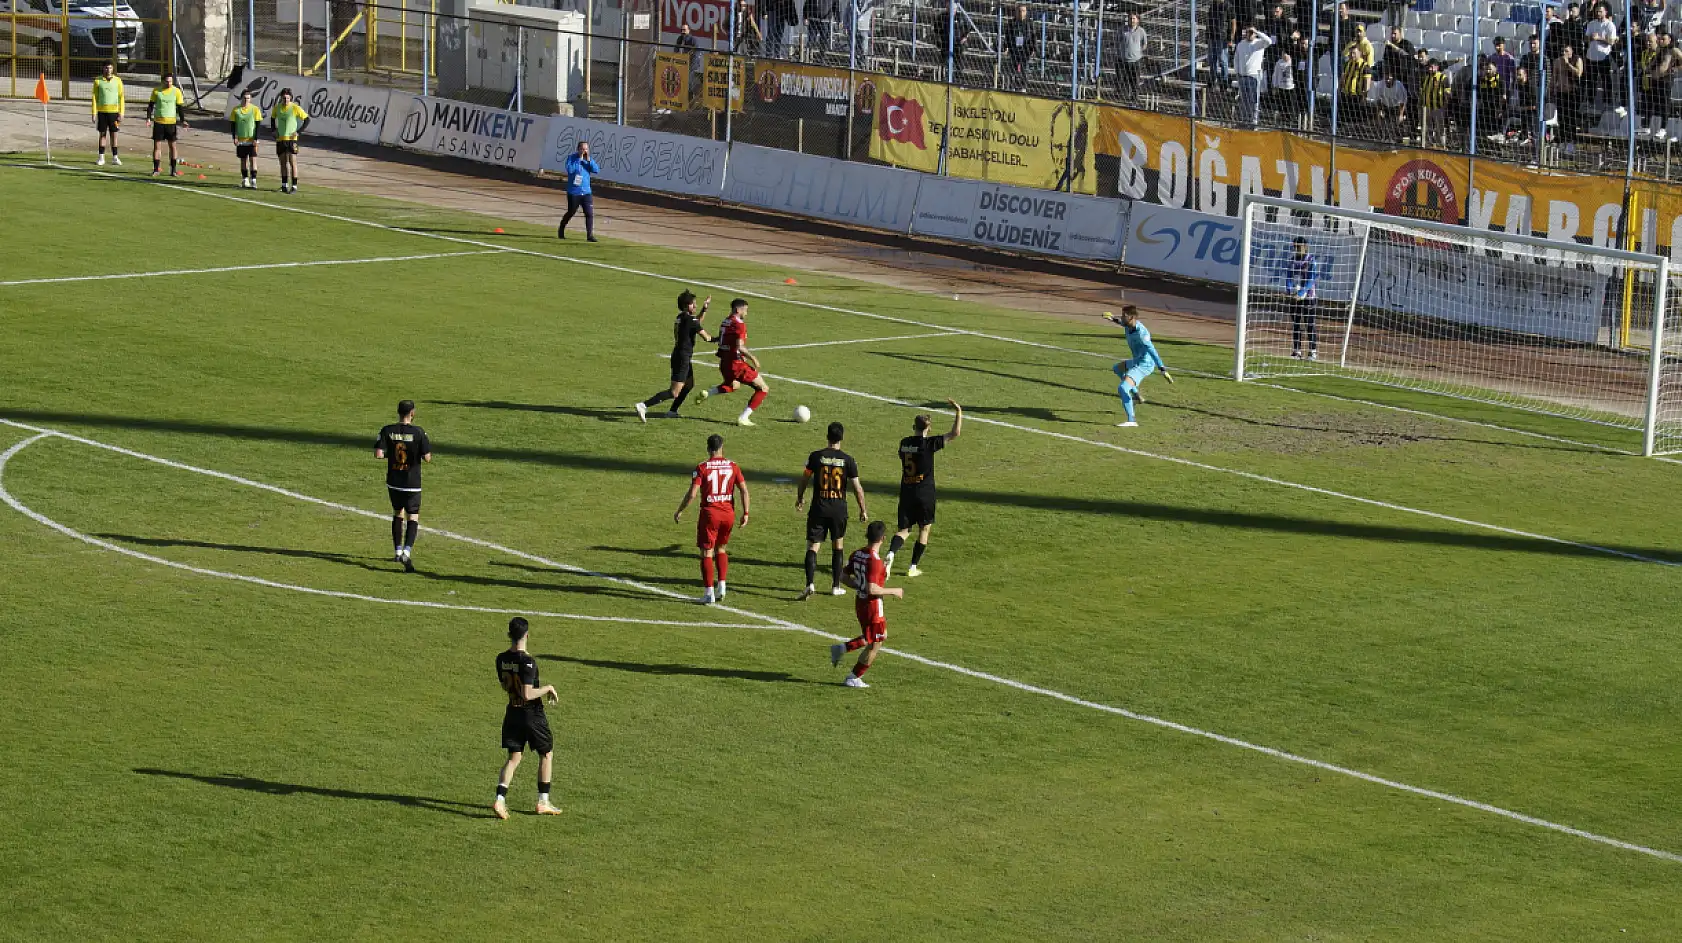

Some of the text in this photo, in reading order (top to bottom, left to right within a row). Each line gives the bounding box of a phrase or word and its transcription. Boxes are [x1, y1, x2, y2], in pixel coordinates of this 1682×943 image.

[431, 102, 534, 143] MAVİKENT
[954, 103, 987, 119] İSKELE
[436, 136, 517, 163] ASANSÖR
[1009, 132, 1039, 148] DOLU
[638, 139, 719, 185] BEACH
[1117, 130, 1369, 237] BOĞAZIN
[1392, 172, 1418, 199] SPOR
[979, 185, 1067, 221] DİSCOVER
[974, 215, 1062, 250] ÖLÜDENİZ
[395, 442, 407, 464] 6
[904, 451, 917, 477] 5
[706, 469, 734, 495] 17
